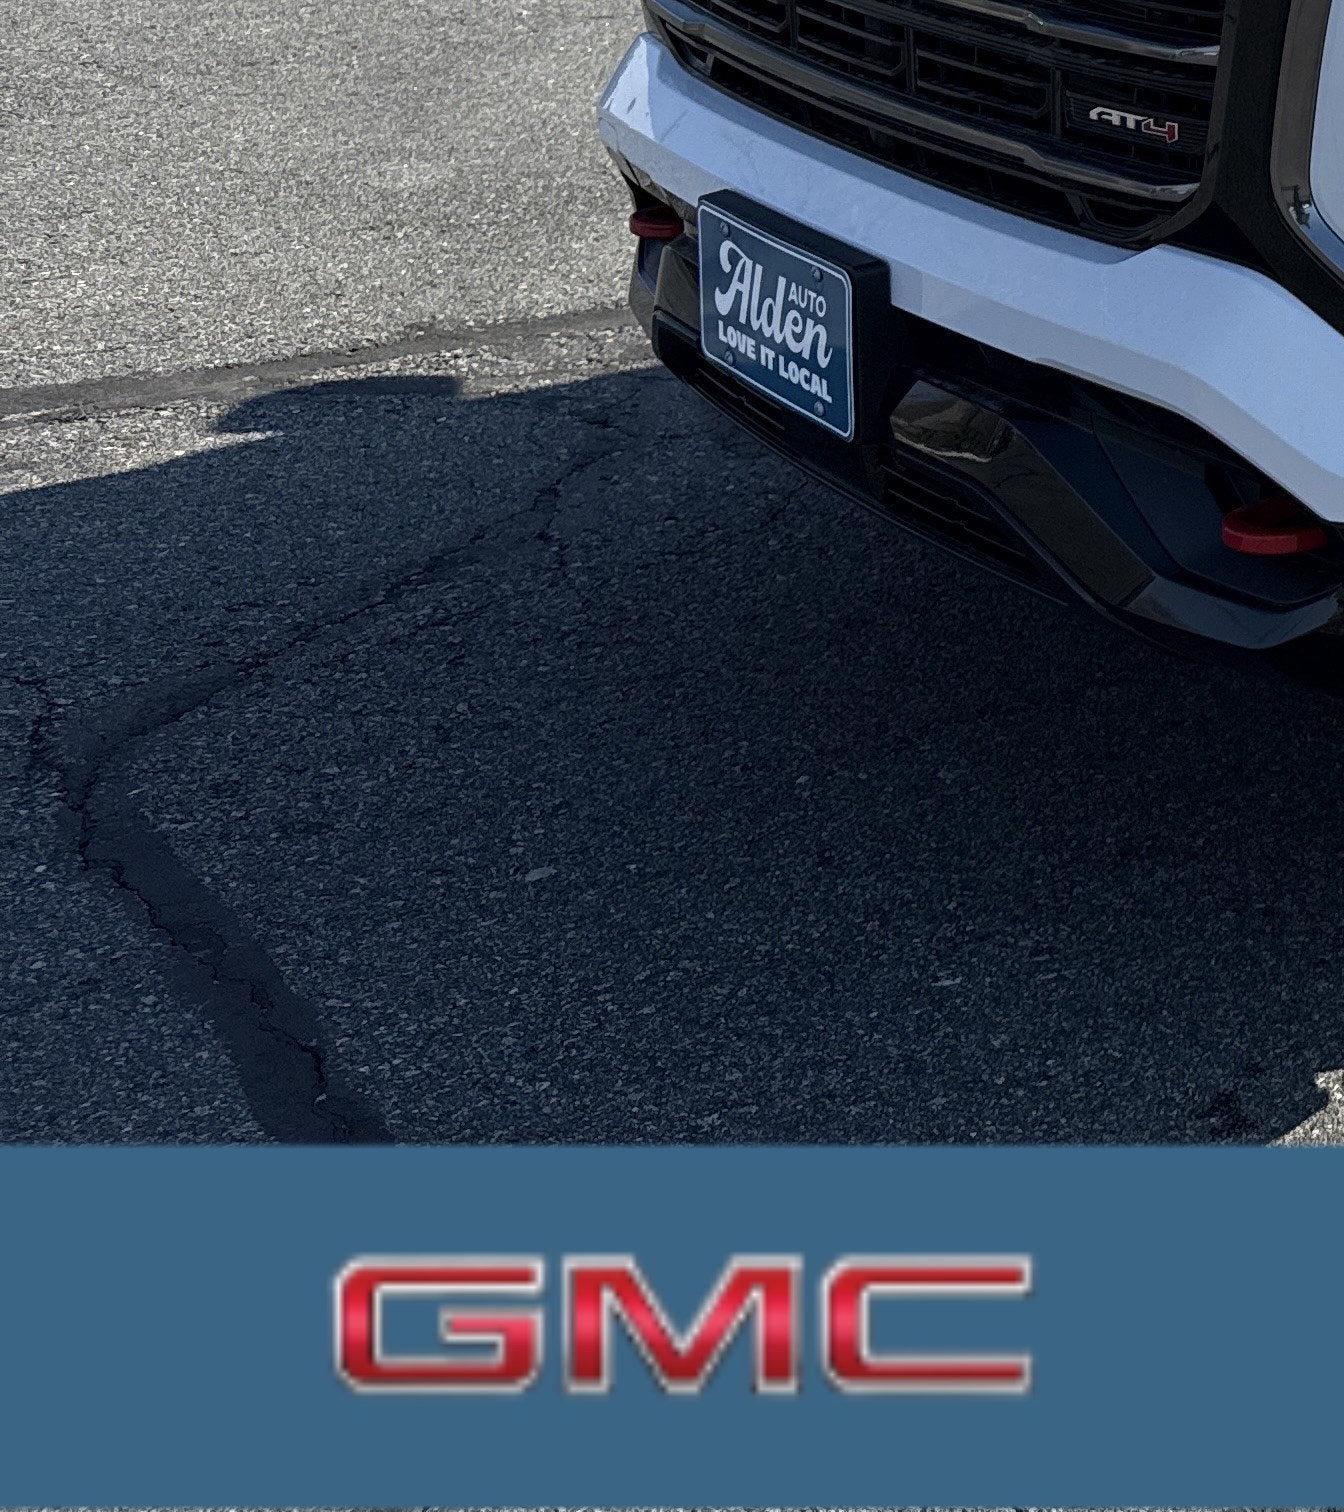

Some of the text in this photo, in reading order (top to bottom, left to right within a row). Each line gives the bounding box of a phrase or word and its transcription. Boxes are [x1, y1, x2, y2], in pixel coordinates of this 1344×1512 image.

[1089, 106, 1179, 144] AT4
[714, 239, 833, 369] Alden
[788, 282, 827, 318] AUTO
[718, 319, 833, 404] LOVE IT LOCAL
